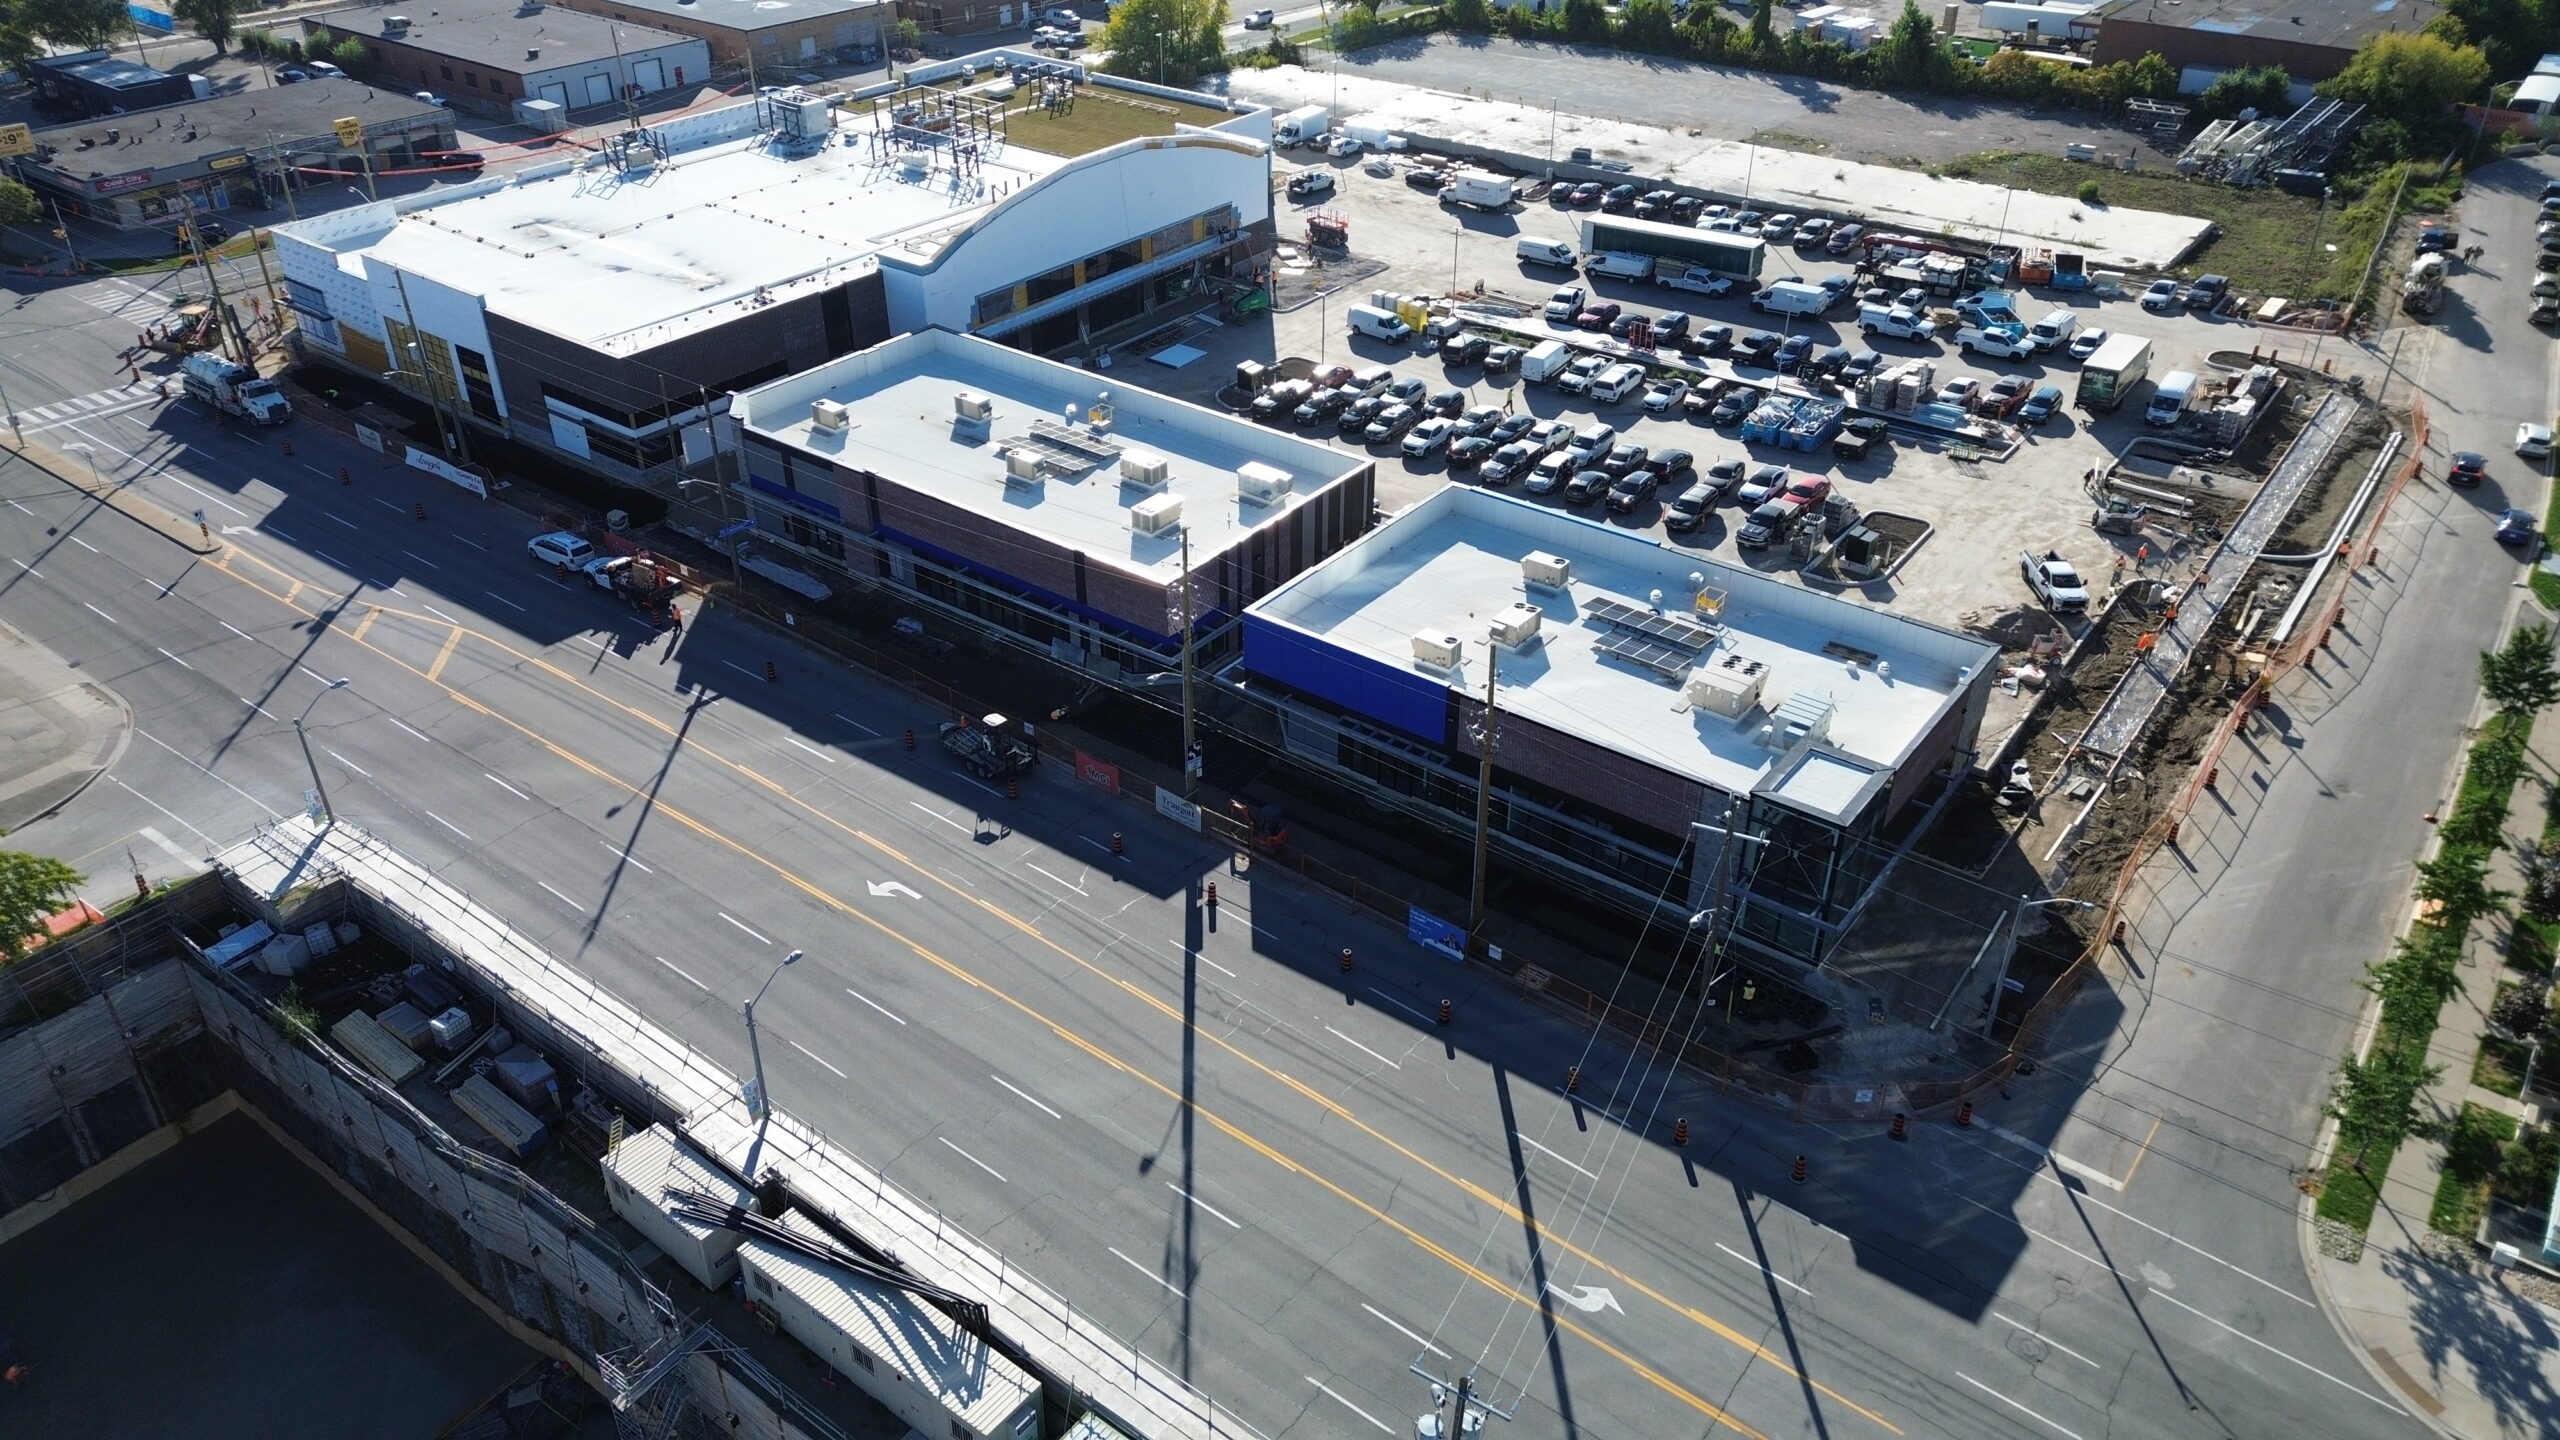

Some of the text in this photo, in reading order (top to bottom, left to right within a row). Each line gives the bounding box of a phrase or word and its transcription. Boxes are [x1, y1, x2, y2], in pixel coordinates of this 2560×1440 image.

[104, 178, 125, 188] Cash
[125, 175, 142, 184] City
[1161, 795, 1195, 819] Traugott
